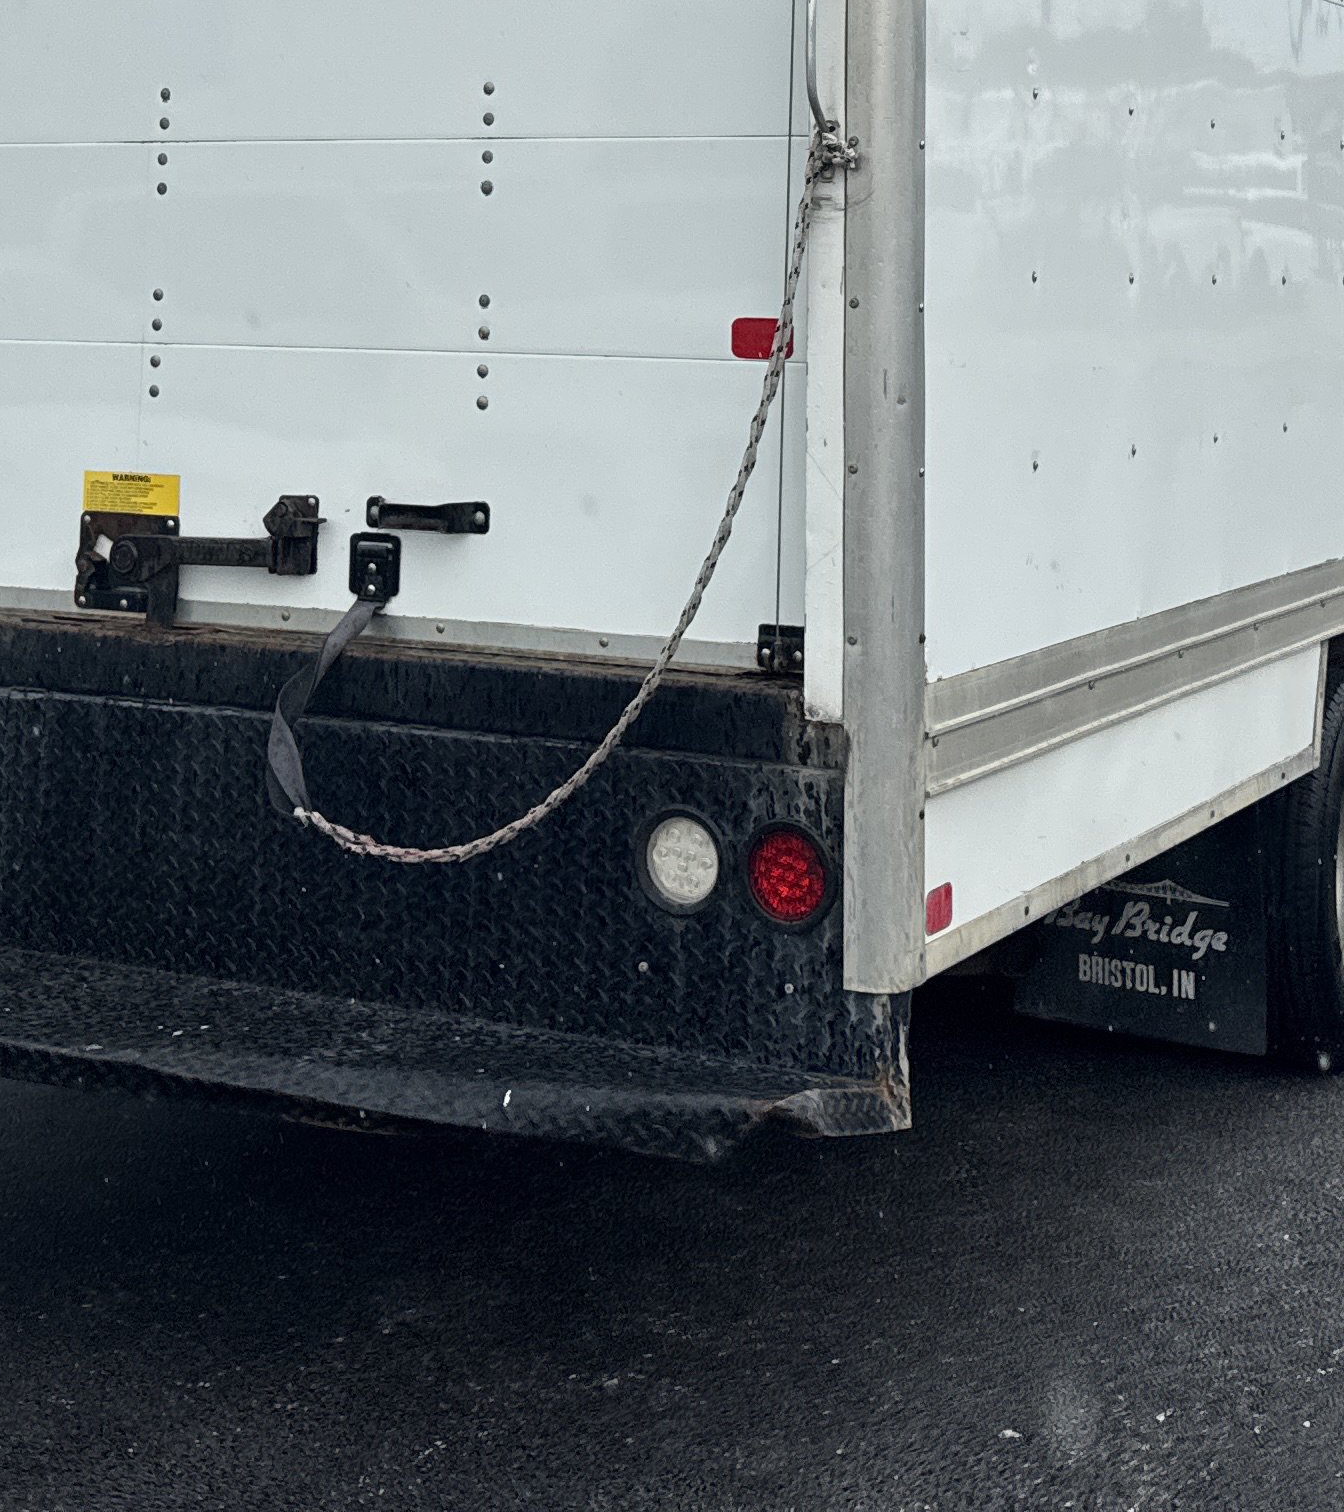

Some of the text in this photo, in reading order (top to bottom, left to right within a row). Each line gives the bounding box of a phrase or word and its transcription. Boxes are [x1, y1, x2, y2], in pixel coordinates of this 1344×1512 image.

[1111, 901, 1229, 960] Bridge
[1078, 953, 1196, 1000] BRISTOL, IN
